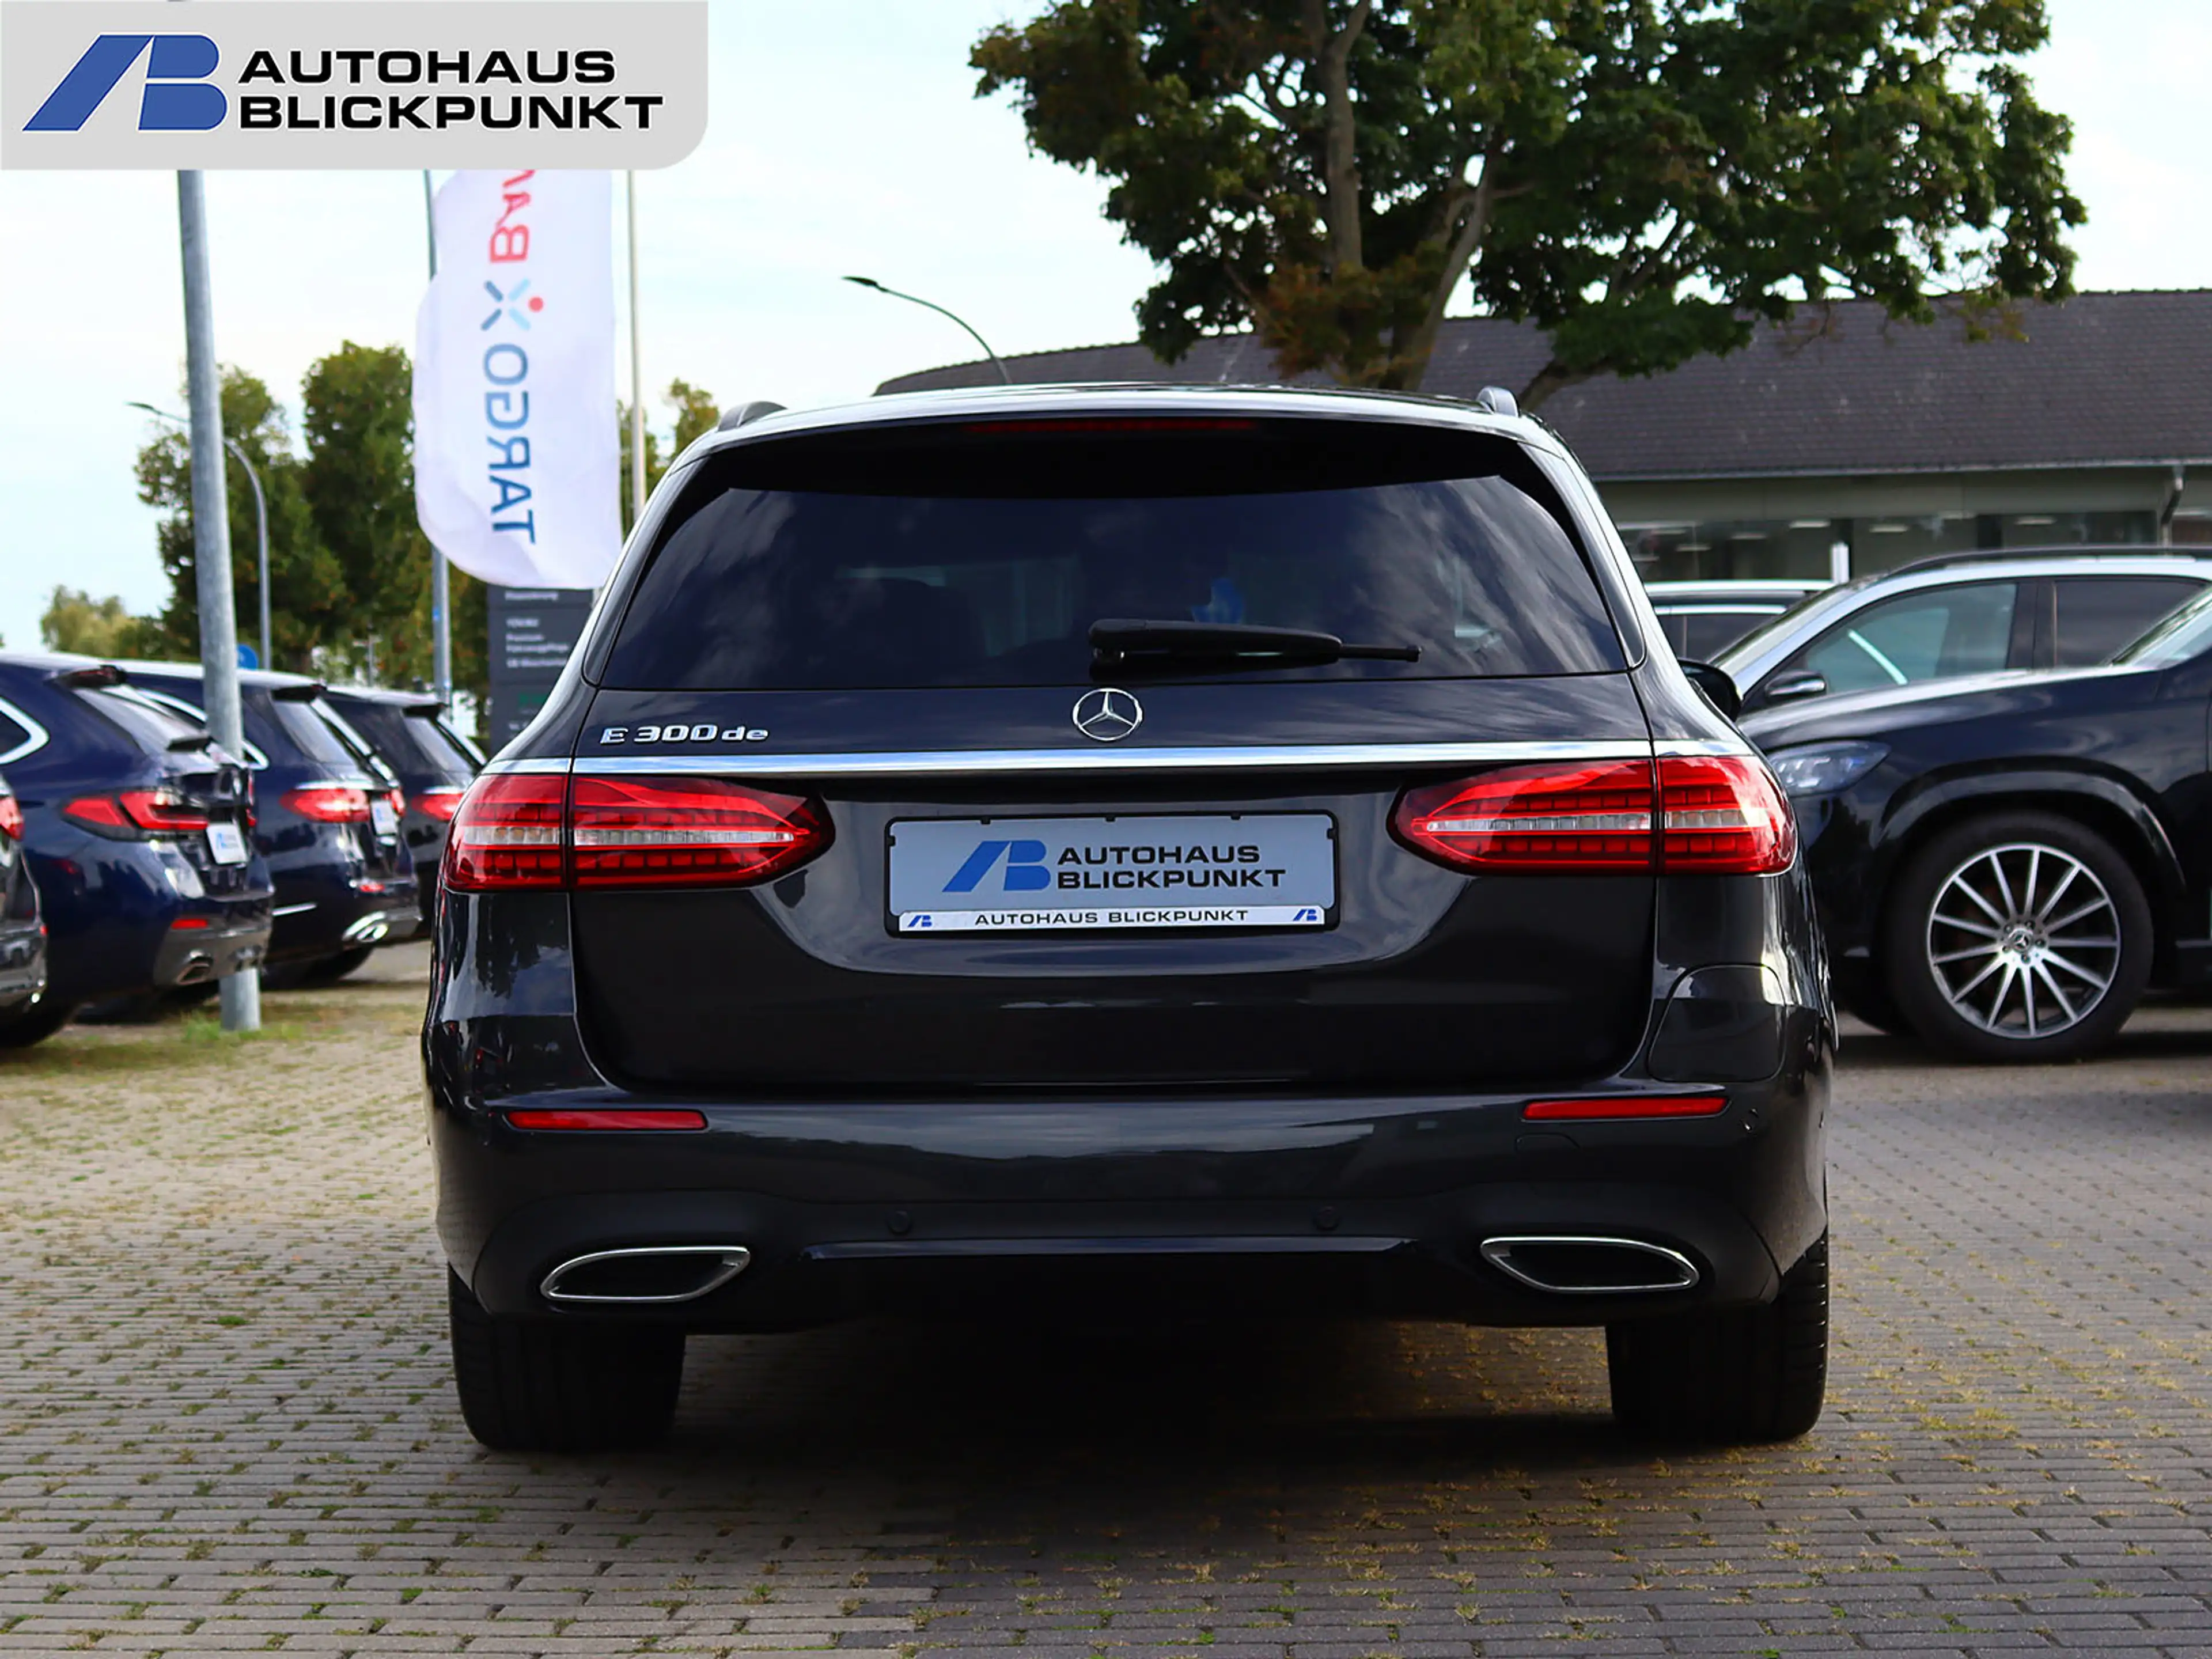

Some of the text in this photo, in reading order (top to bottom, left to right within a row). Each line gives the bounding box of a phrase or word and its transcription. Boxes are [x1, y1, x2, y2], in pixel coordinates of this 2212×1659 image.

[600, 724, 768, 744] E 300 de
[1058, 845, 1260, 865] AUTOHAUS
[1058, 869, 1286, 890] BLICKPUNKT
[975, 912, 1098, 926] AUTOHAUS
[1108, 909, 1248, 923] BLICKPUNKT
